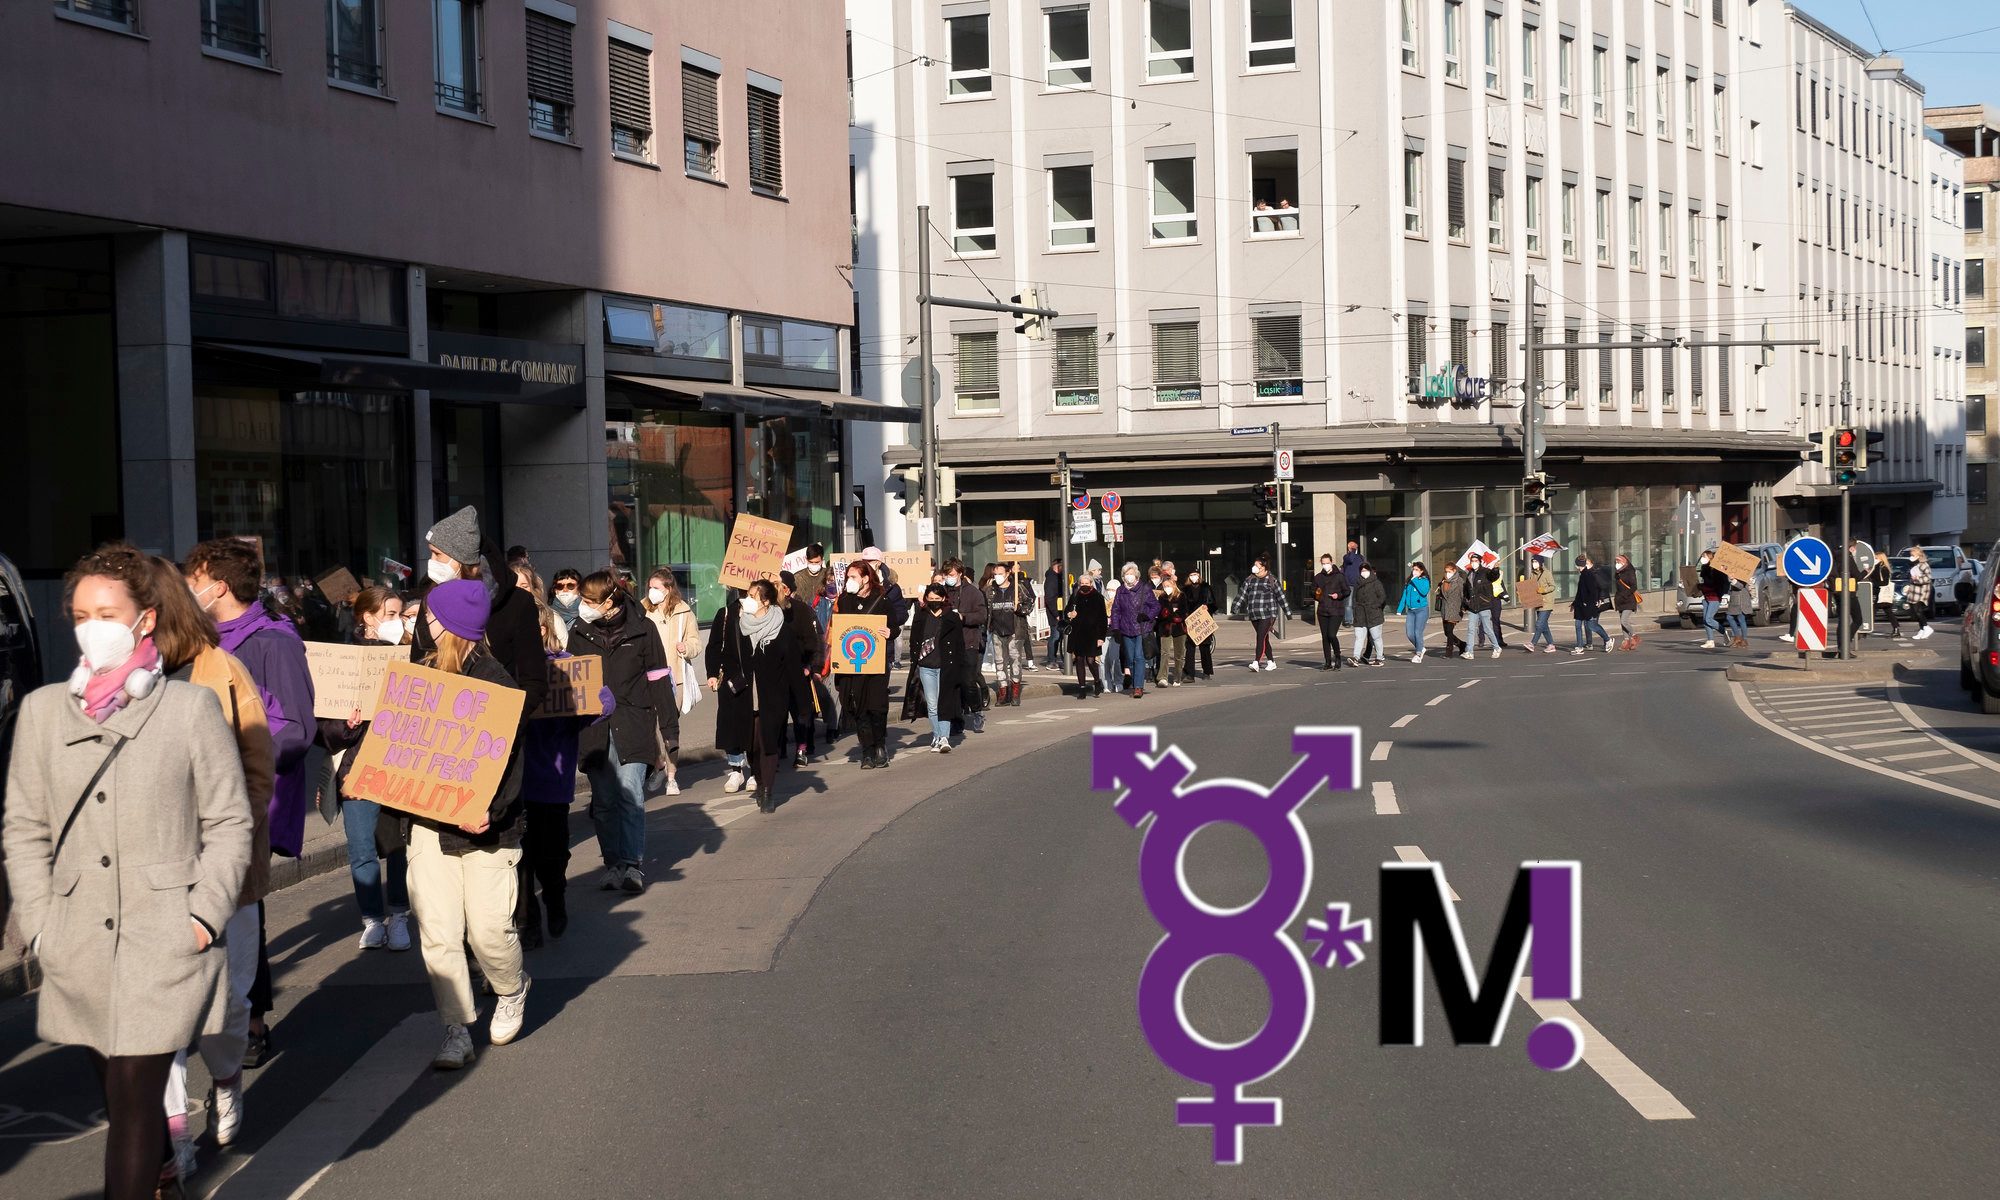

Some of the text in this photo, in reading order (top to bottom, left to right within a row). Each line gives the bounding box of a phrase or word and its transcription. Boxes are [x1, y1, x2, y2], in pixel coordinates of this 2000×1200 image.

[733, 533, 778, 555] SEXIST
[549, 659, 593, 685] EHRT
[383, 671, 489, 722] MEN OF
[543, 685, 587, 714] EUCH
[372, 709, 508, 761] QUALITY DO
[383, 743, 479, 783] NOT FEAR
[352, 764, 476, 818] EQUALITY
